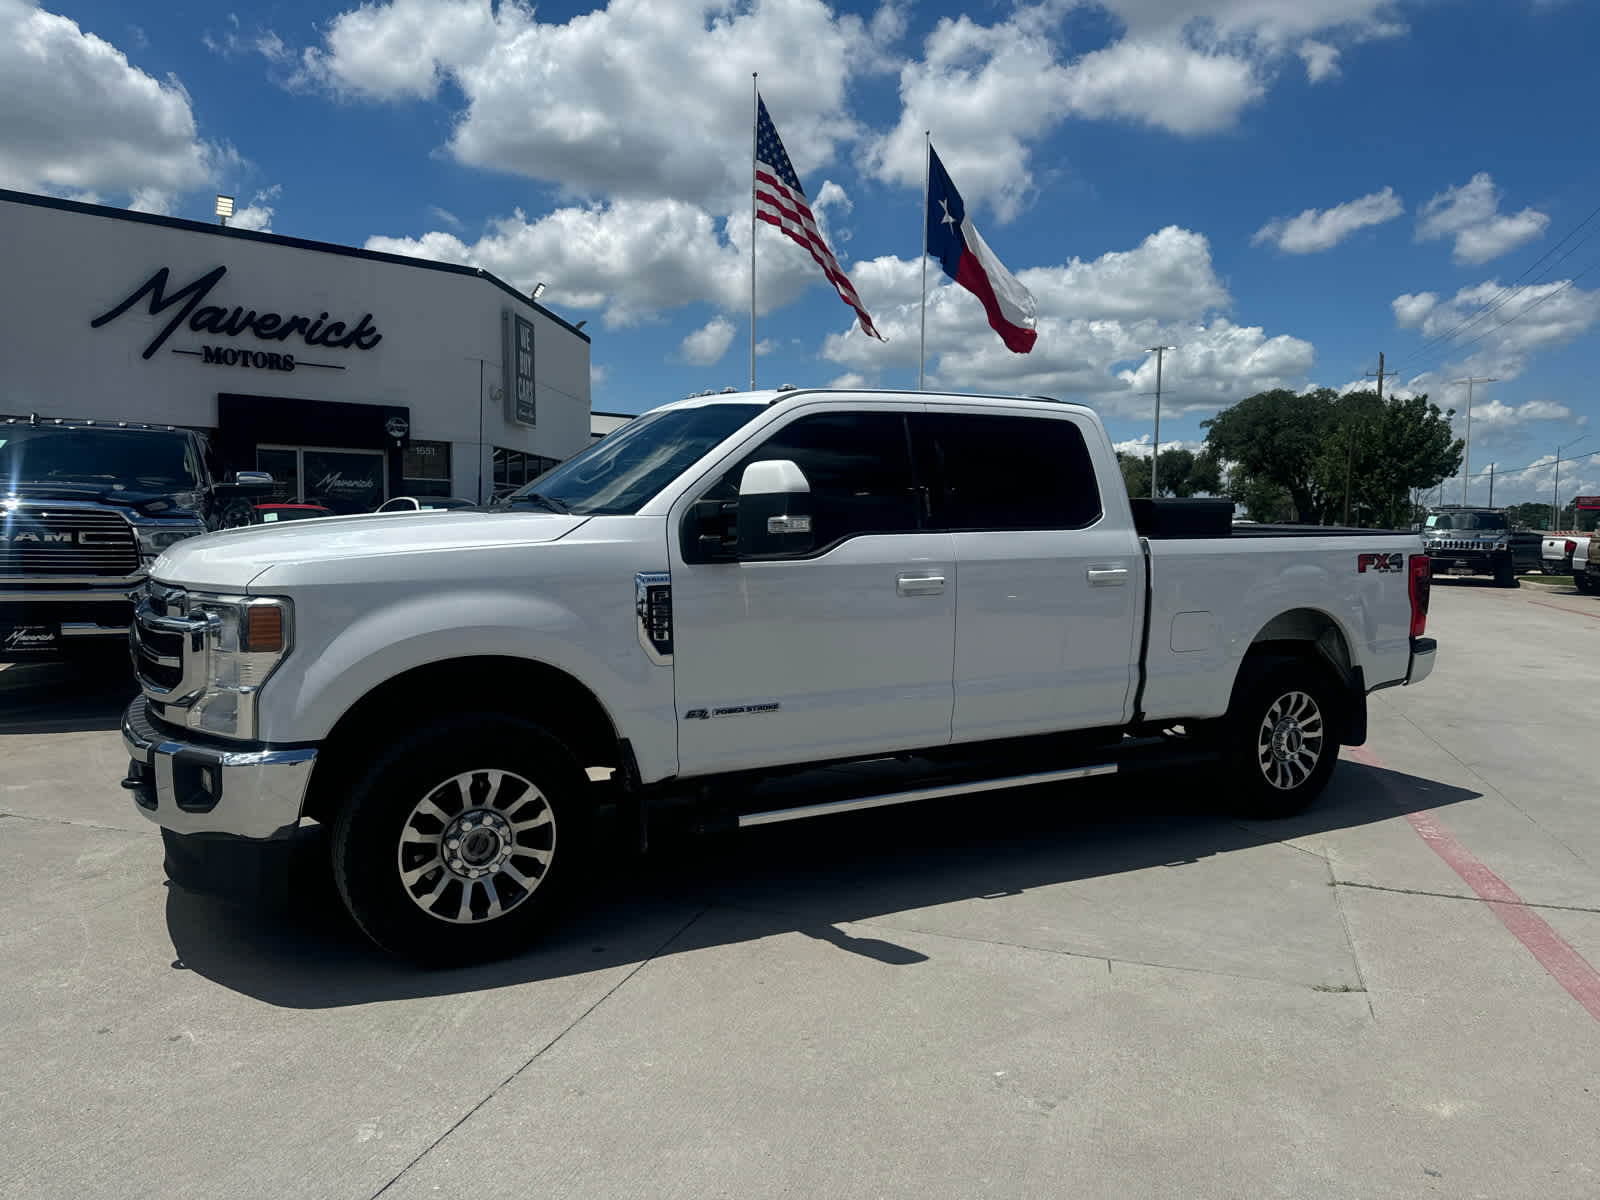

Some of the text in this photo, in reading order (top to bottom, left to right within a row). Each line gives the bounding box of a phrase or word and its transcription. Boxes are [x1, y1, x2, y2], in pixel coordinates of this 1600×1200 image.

[91, 265, 383, 360] Maverick
[201, 345, 296, 372] MOTORS
[1357, 553, 1403, 573] FX4
